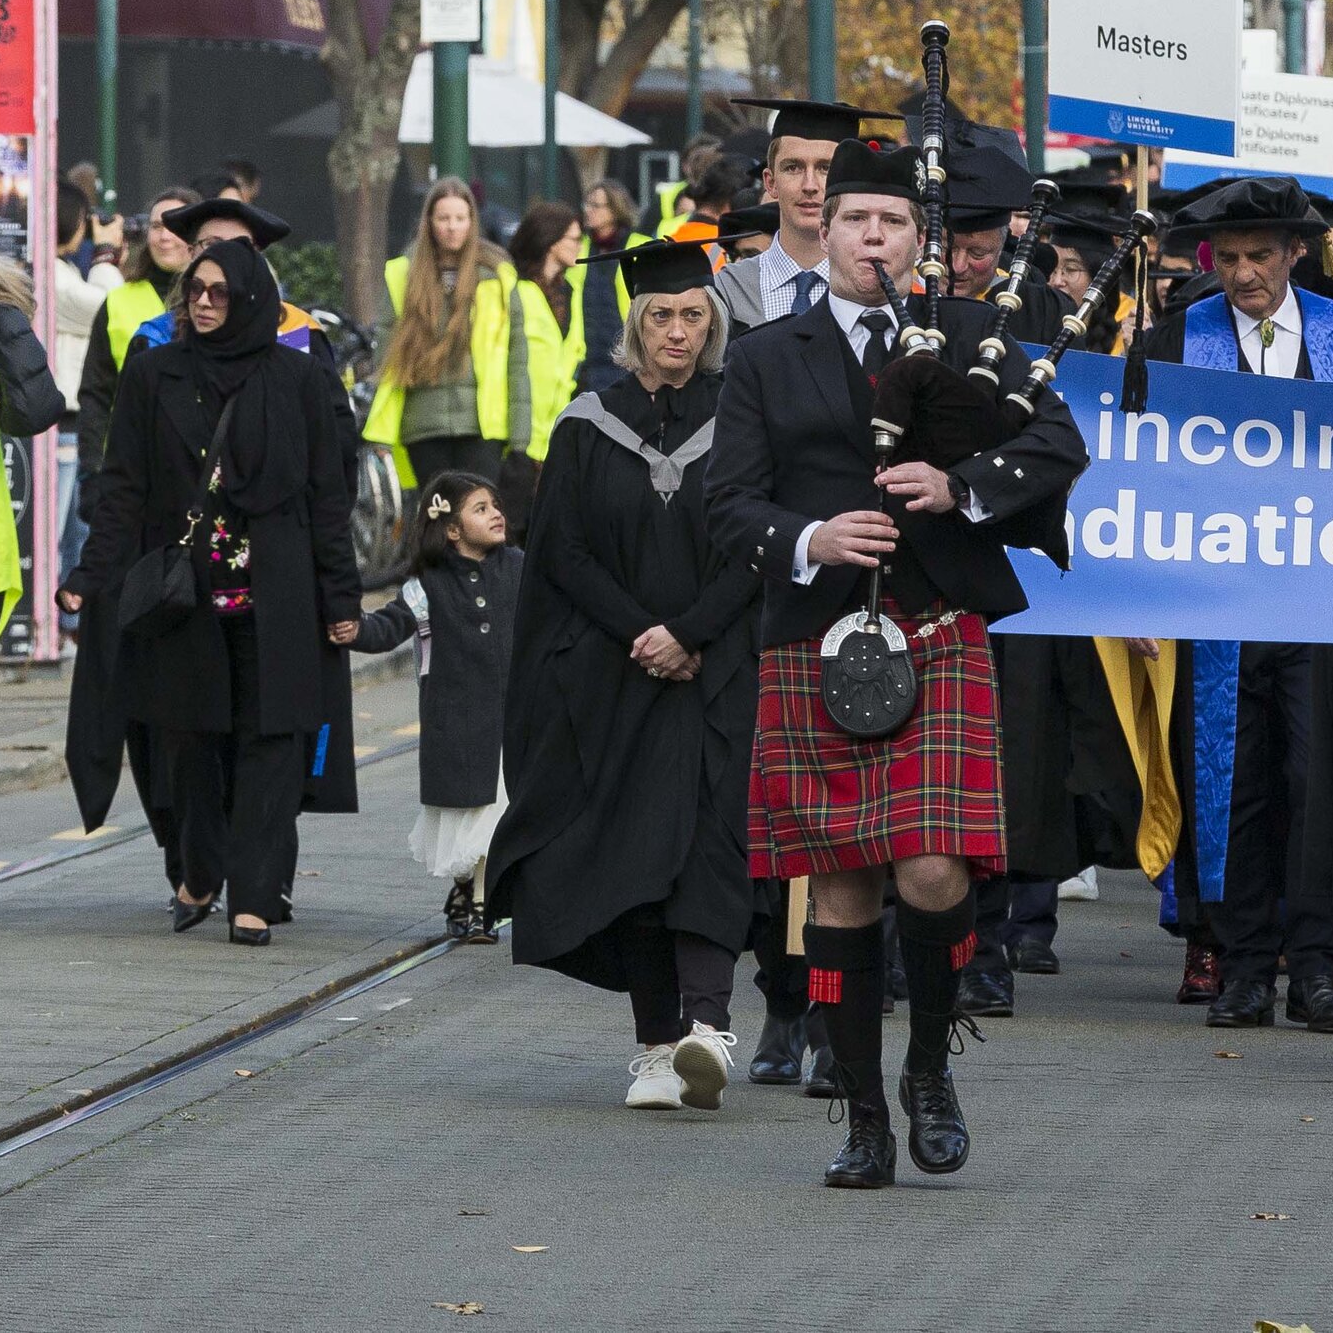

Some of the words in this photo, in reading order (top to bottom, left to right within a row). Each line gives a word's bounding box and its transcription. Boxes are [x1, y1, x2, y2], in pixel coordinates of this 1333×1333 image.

[1097, 25, 1188, 61] Masters
[1127, 115, 1160, 126] LINCOLN
[1127, 122, 1175, 135] UNIVERSITY
[1256, 127, 1320, 143] Diplomas
